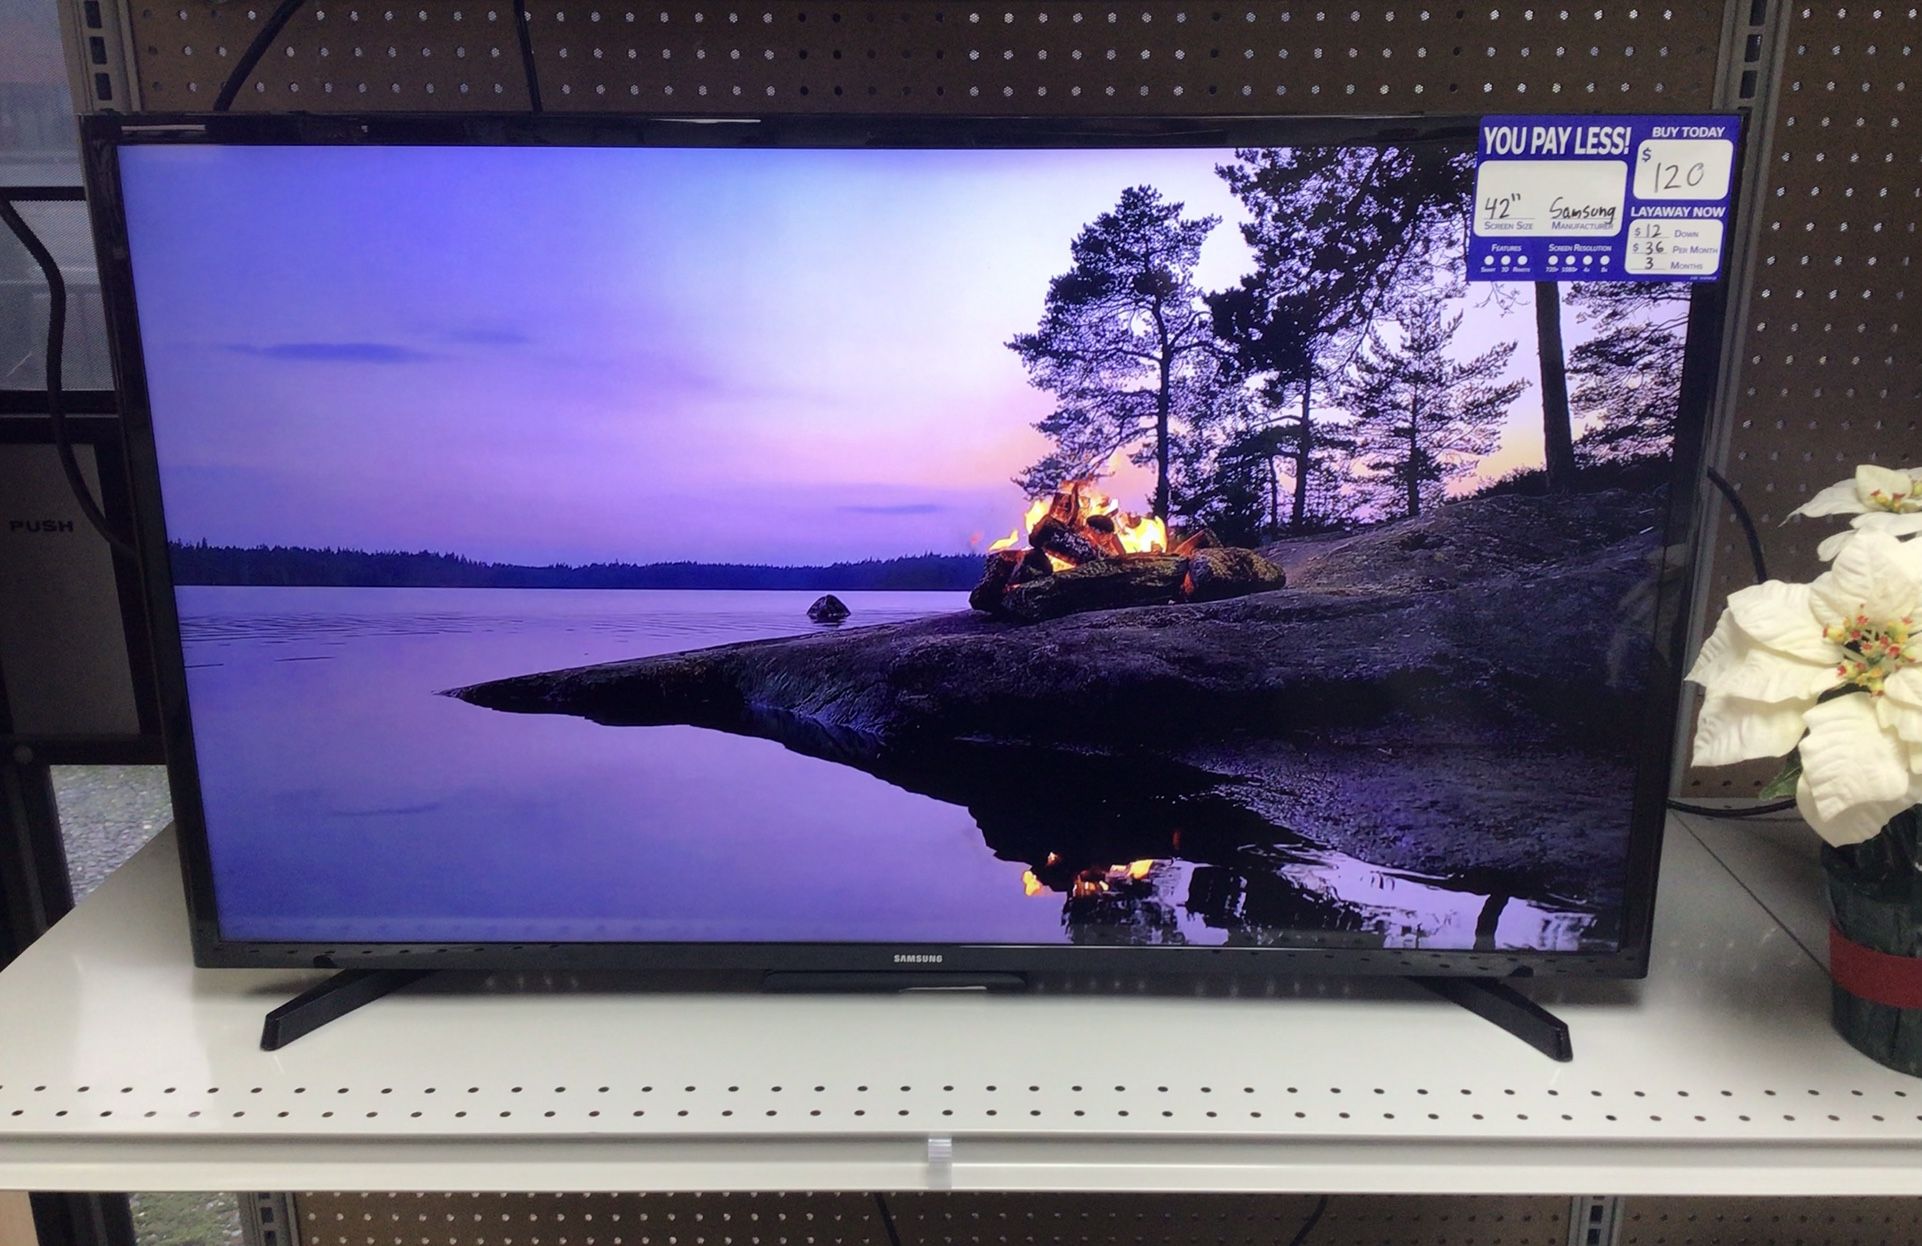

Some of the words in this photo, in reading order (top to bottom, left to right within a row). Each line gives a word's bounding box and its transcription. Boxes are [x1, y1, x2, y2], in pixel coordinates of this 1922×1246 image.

[1652, 126, 1679, 138] BUY
[1681, 126, 1726, 138] TODAY
[1484, 126, 1527, 155] YOU
[1530, 126, 1572, 155] PAY
[1574, 126, 1632, 155] LESS!
[1642, 147, 1652, 162] $
[1654, 162, 1704, 193] 120
[1549, 196, 1617, 225] Samsung
[1630, 206, 1691, 217] LAYAWAY
[1692, 206, 1726, 217] NOW
[1646, 224, 1662, 238] 12
[1645, 241, 1664, 255] 36
[1644, 256, 1654, 270] 3
[9, 519, 74, 533] PUSH
[893, 954, 943, 963] SAMSUNG
